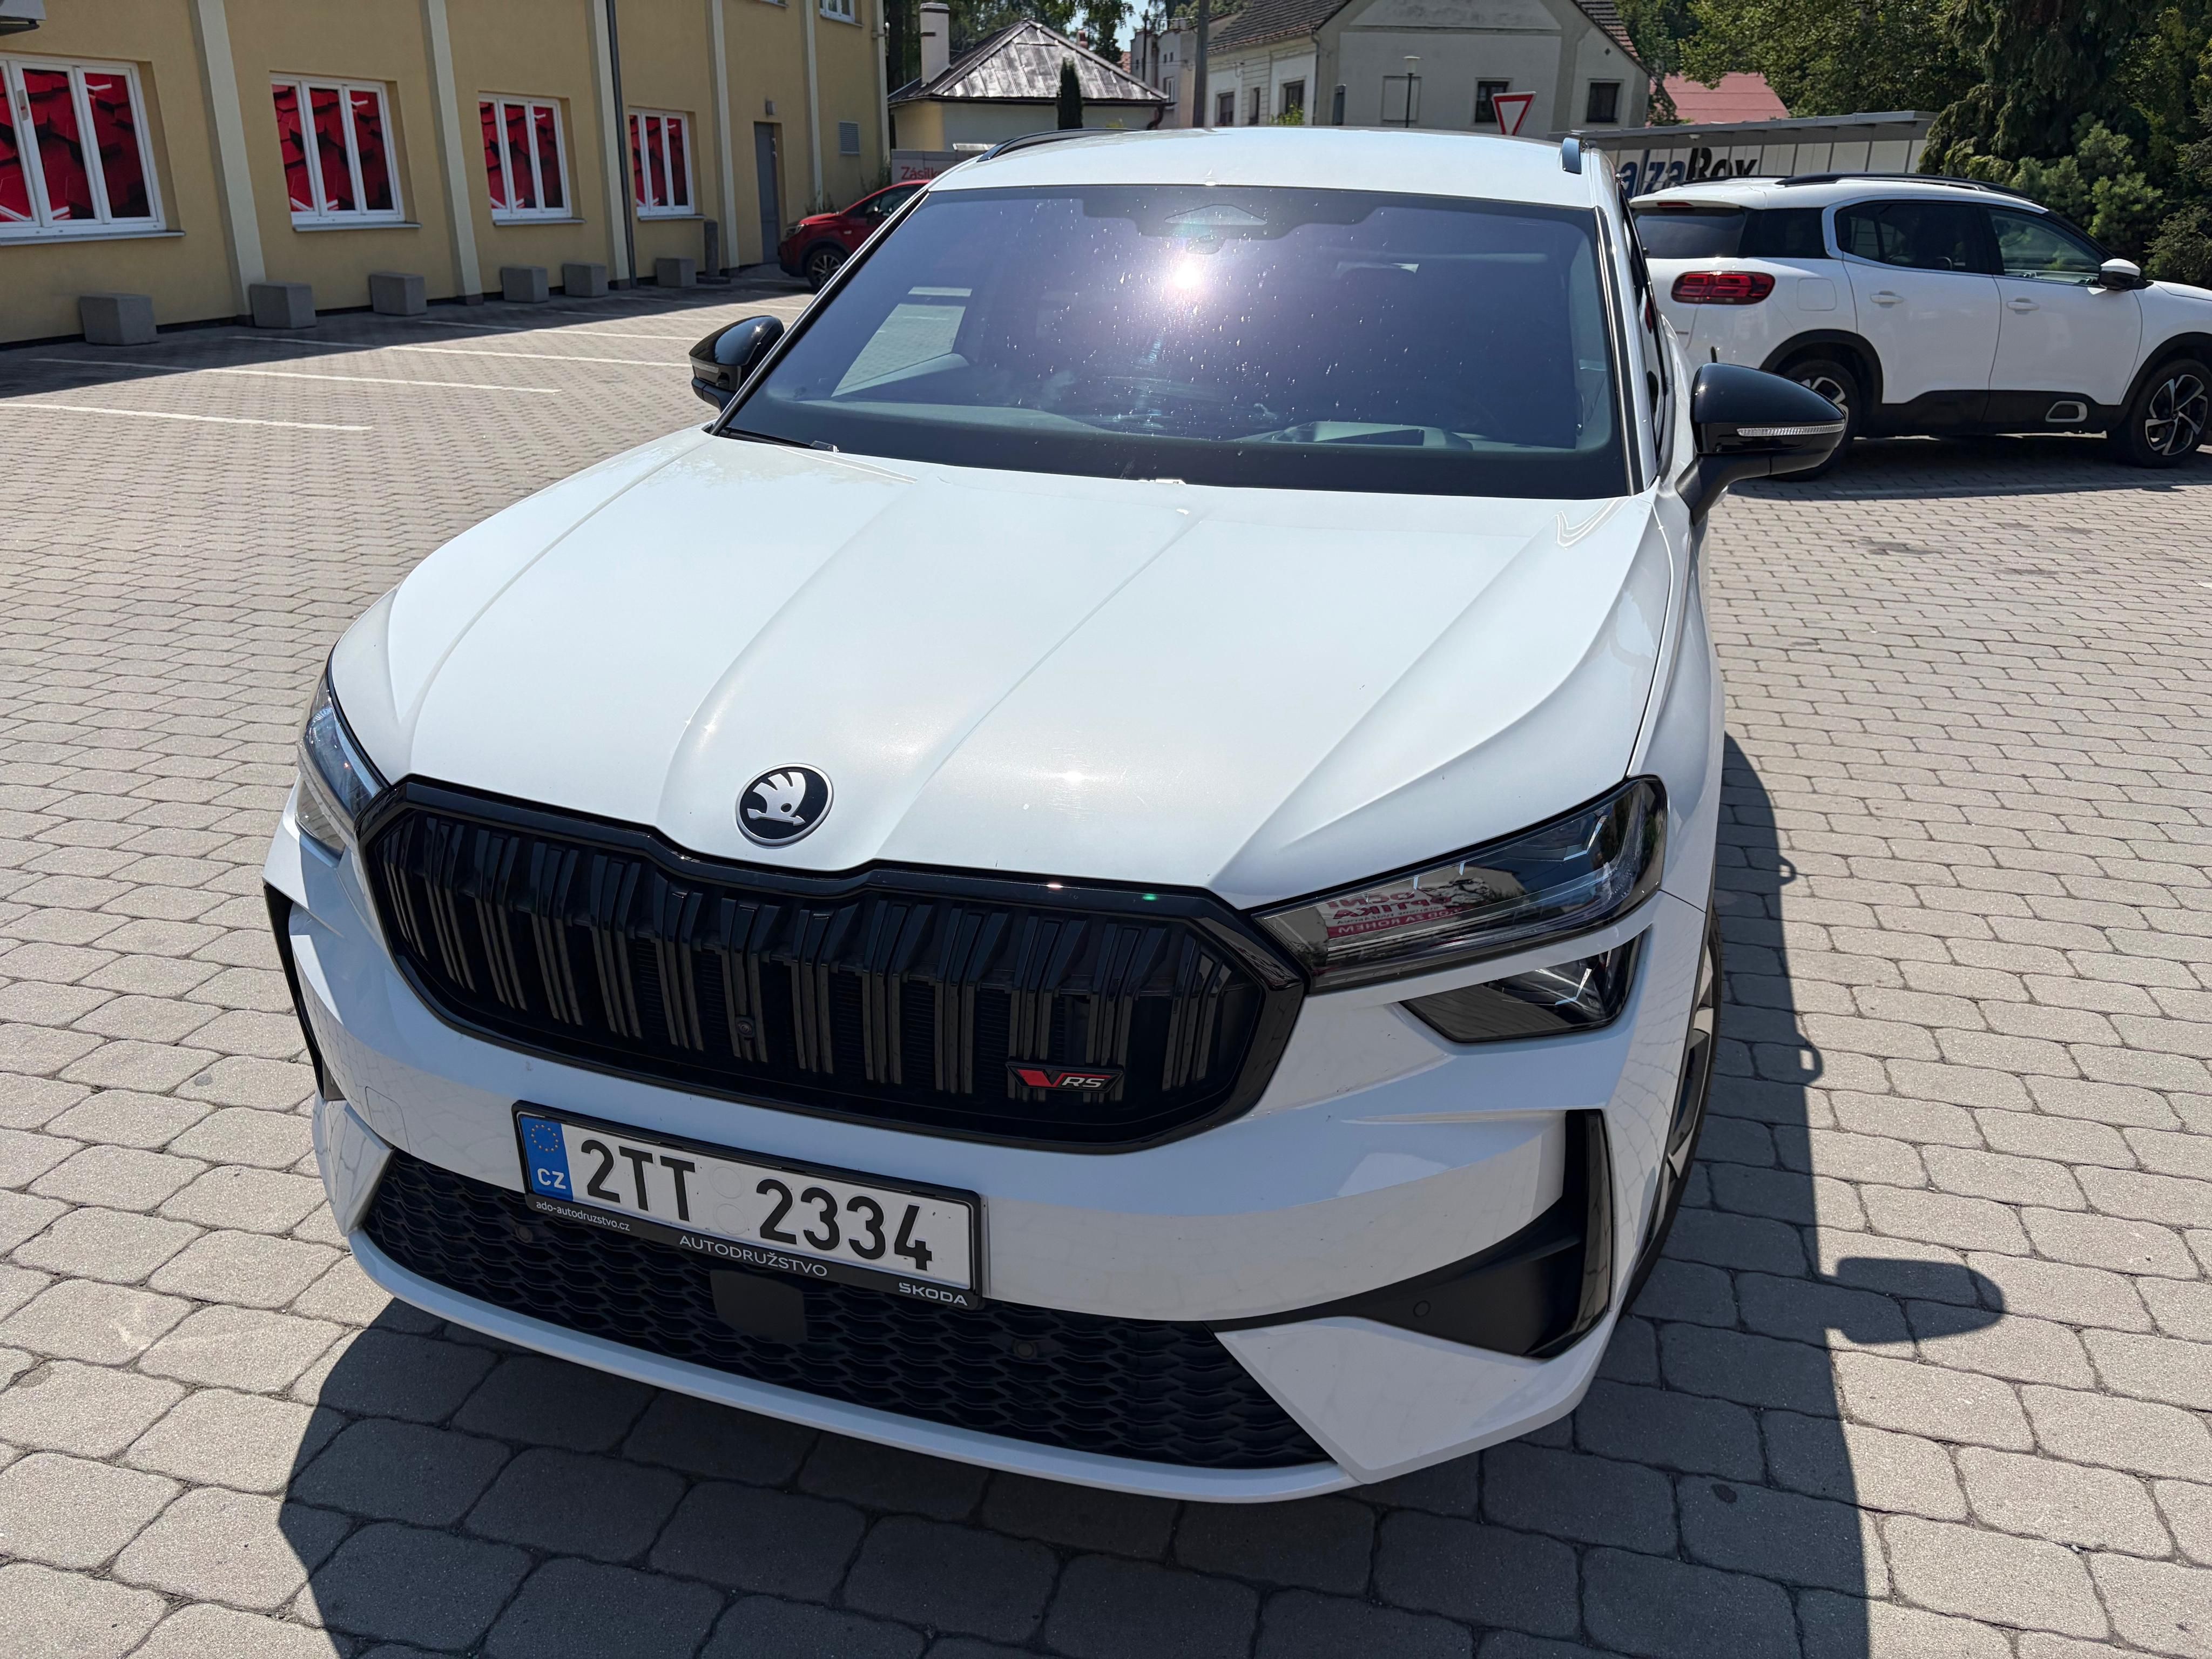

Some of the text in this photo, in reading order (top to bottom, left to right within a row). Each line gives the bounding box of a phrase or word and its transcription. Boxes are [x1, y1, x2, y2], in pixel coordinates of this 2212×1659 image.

[901, 165, 943, 180] Zásilk
[537, 1168, 567, 1190] CZ
[535, 1200, 631, 1232] ado-autodruzstvo.cz
[580, 1139, 933, 1271] 2TT 2334
[679, 1235, 828, 1277] AUTODRUŽSTVO
